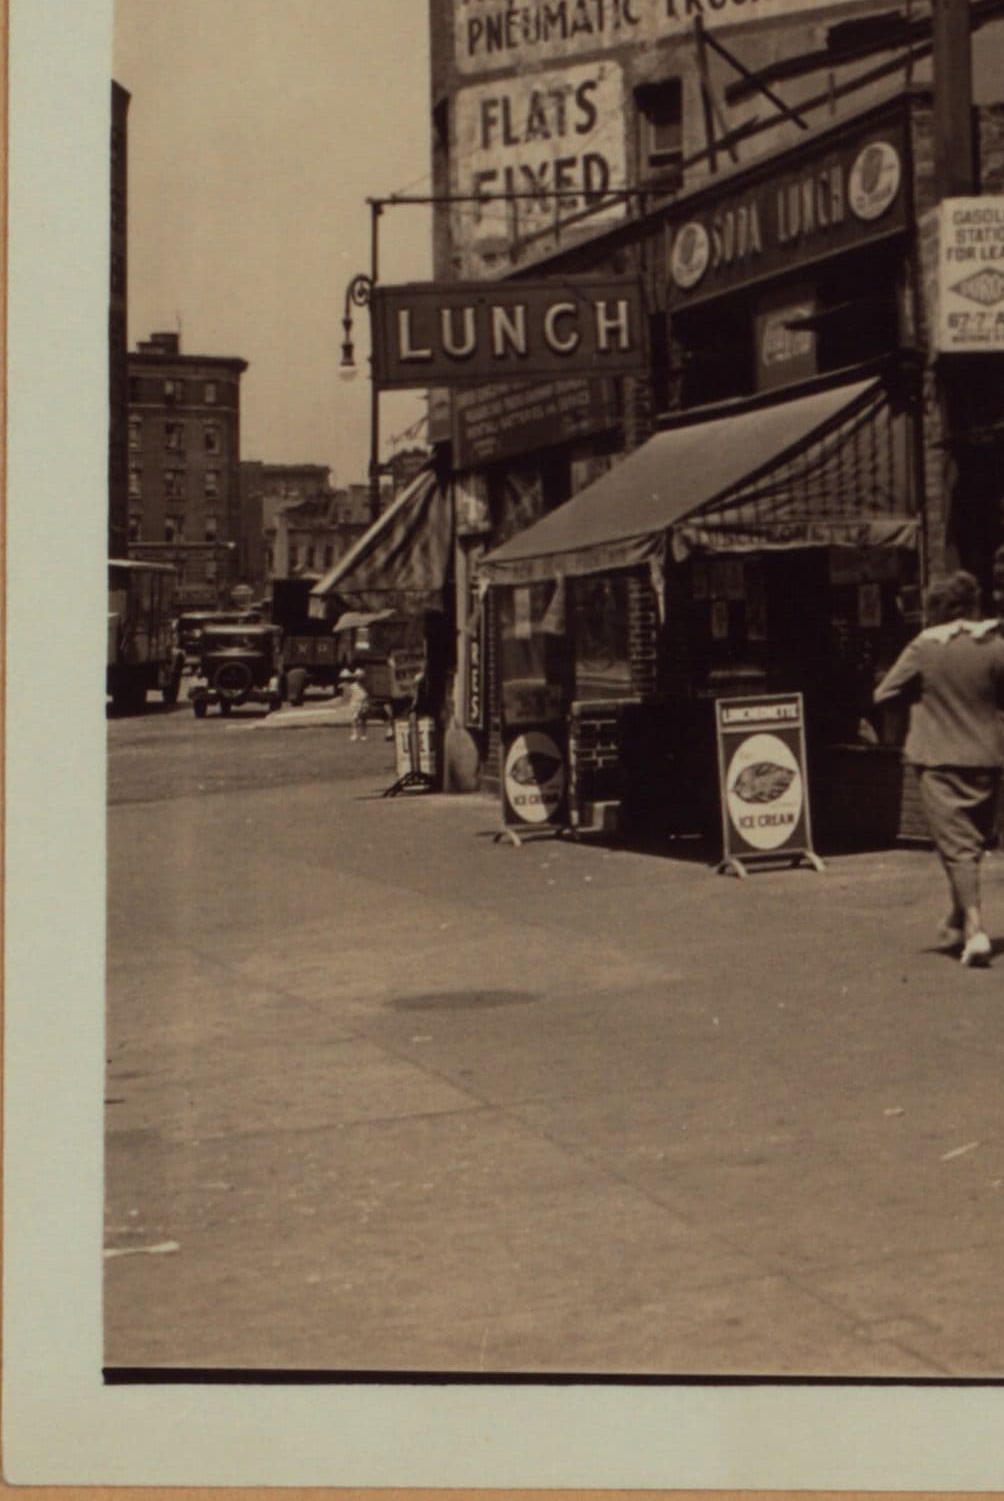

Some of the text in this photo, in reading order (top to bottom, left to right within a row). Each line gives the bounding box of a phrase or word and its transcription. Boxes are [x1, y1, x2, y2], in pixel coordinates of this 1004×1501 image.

[480, 79, 598, 150] FLATS
[472, 152, 610, 226] FIXED
[776, 164, 845, 242] LUNCH
[946, 246, 976, 262] FOR
[399, 299, 631, 362] LUNCH
[740, 813, 795, 829] ICE CREAM
